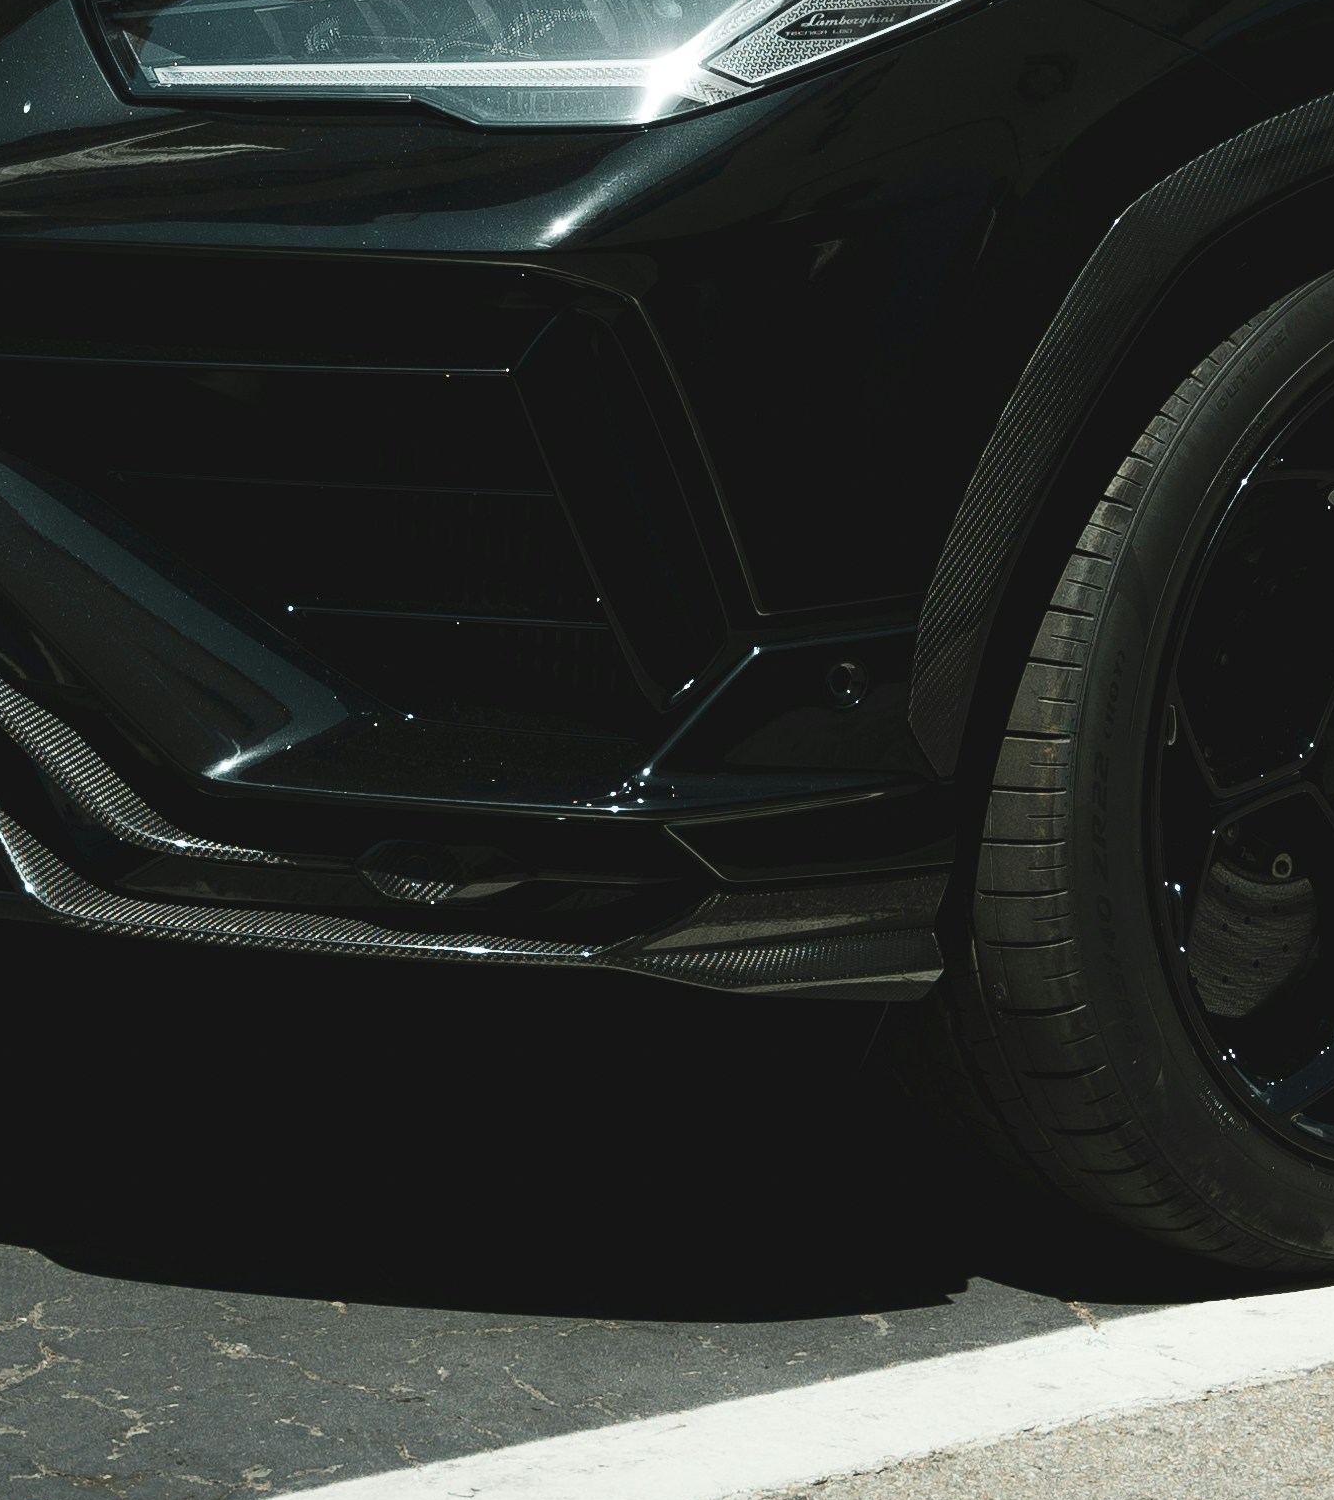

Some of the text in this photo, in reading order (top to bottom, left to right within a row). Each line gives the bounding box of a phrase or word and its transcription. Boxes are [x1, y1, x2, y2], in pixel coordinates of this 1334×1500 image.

[801, 13, 897, 27] Lamborghini
[1215, 328, 1287, 412] OUTSIDE
[1091, 751, 1111, 884] ZR22
